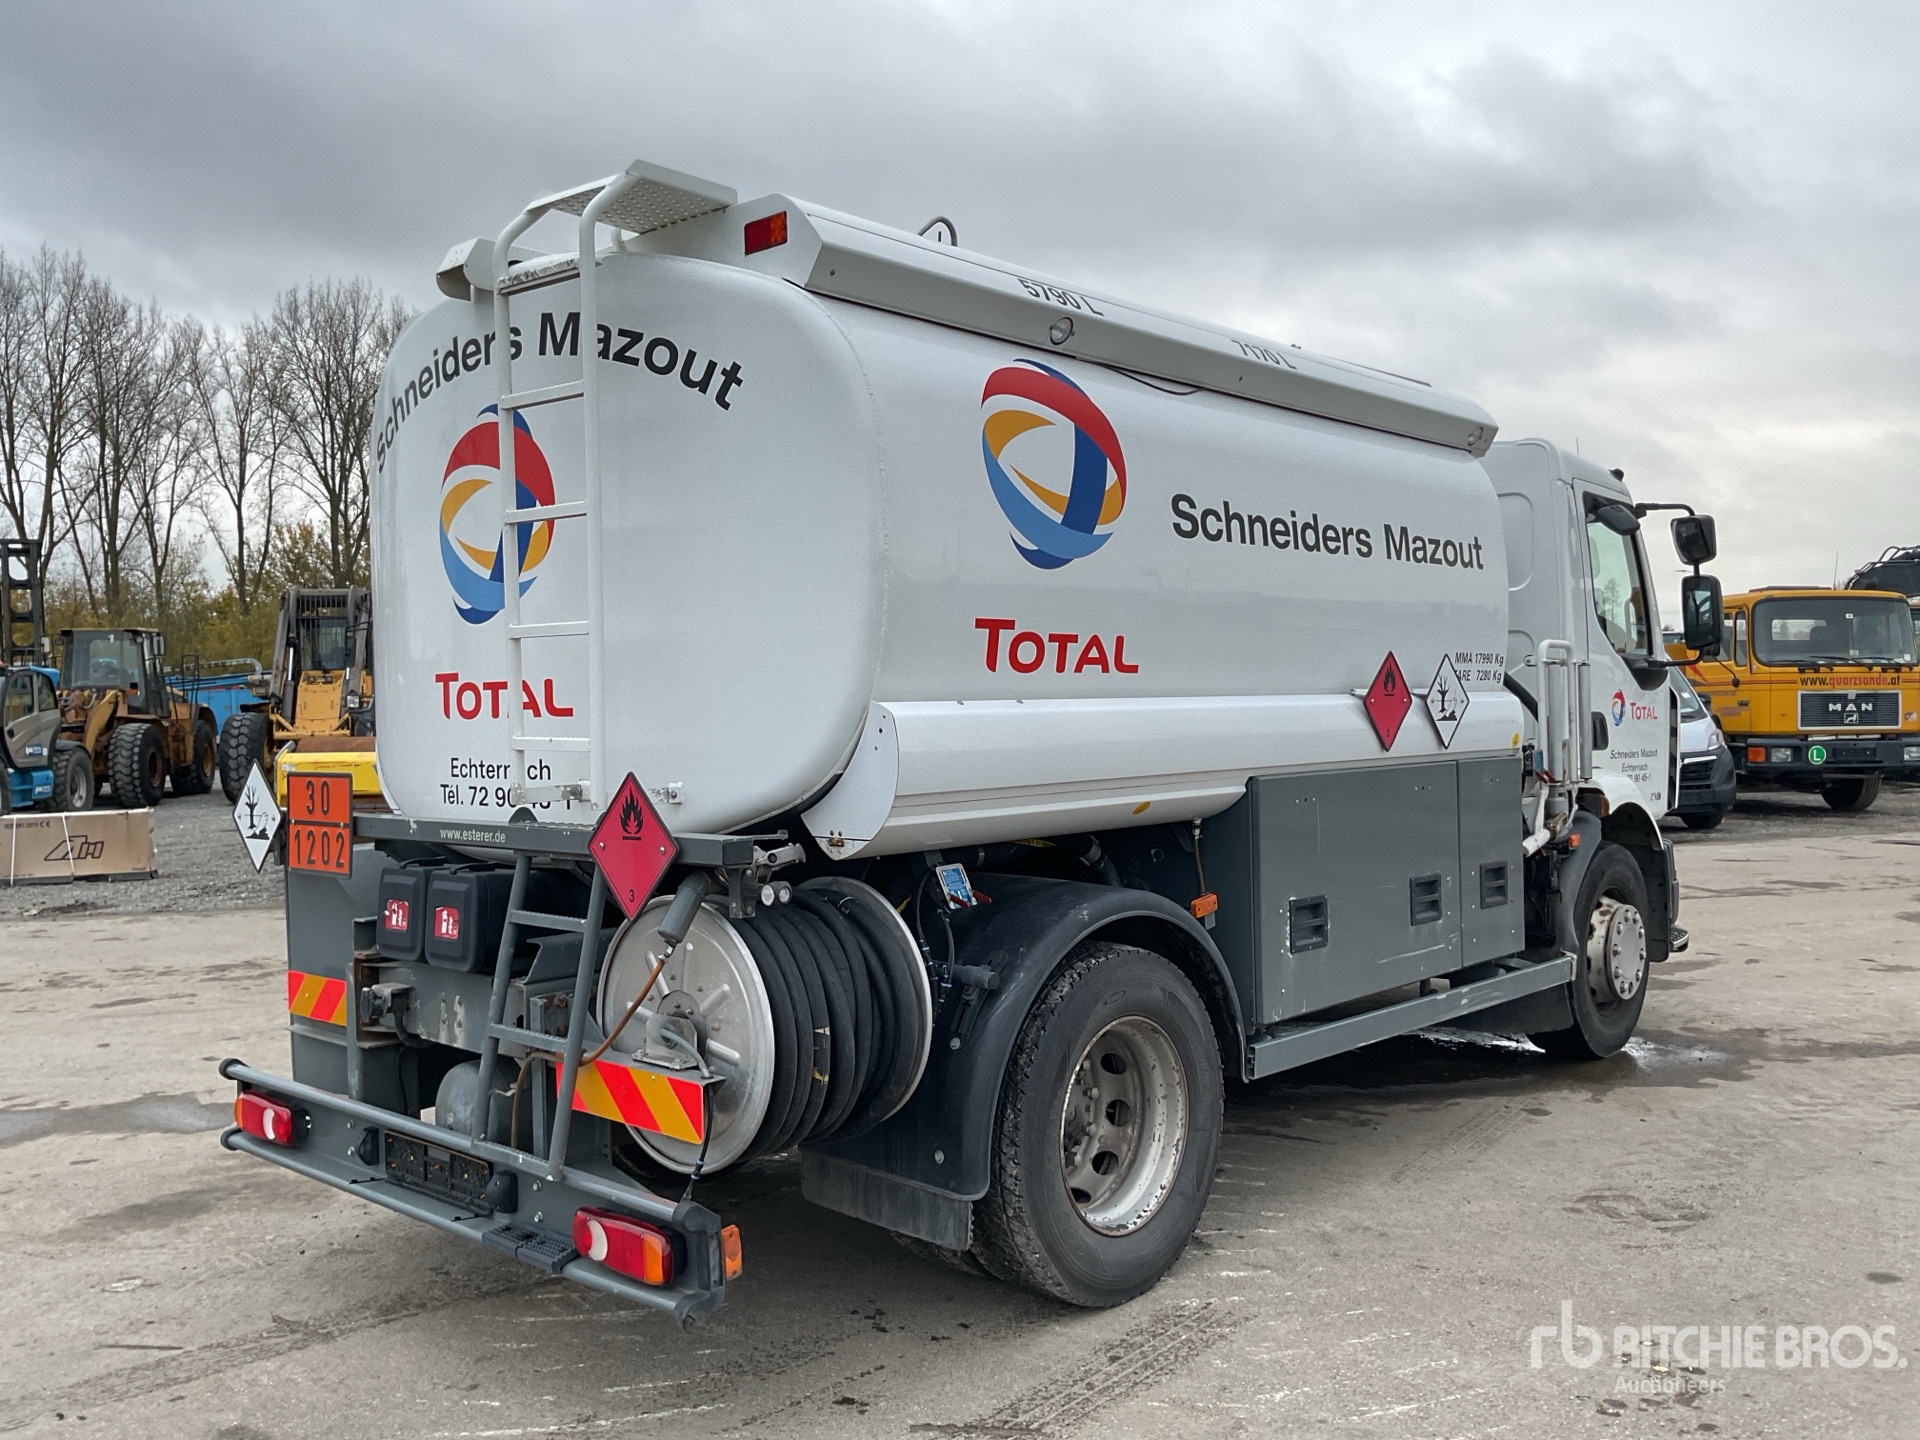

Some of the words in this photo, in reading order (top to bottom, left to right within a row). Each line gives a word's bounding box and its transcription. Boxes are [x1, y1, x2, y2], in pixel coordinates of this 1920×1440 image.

[1017, 278, 1082, 310] 5790
[1080, 296, 1104, 316] L
[1230, 340, 1281, 366] 7170
[1277, 352, 1297, 370] L
[377, 326, 523, 475] Schneiders
[538, 311, 744, 411] Mazout
[1170, 493, 1373, 558] Schneiders
[1383, 523, 1484, 570] Mazout
[1454, 652, 1473, 664] MMA
[1475, 653, 1494, 664] 17990
[1495, 653, 1504, 667] Kg
[1492, 670, 1502, 683] Kg
[1800, 674, 1901, 688] www.quarzsande.at
[1828, 703, 1873, 711] MAN
[1610, 749, 1640, 759] Schneiders
[306, 780, 330, 815] 30
[440, 784, 463, 805] Tél.
[469, 786, 489, 806] 72
[440, 828, 506, 843] www.esterer.de
[294, 829, 345, 868] 1202
[629, 889, 635, 902] 3
